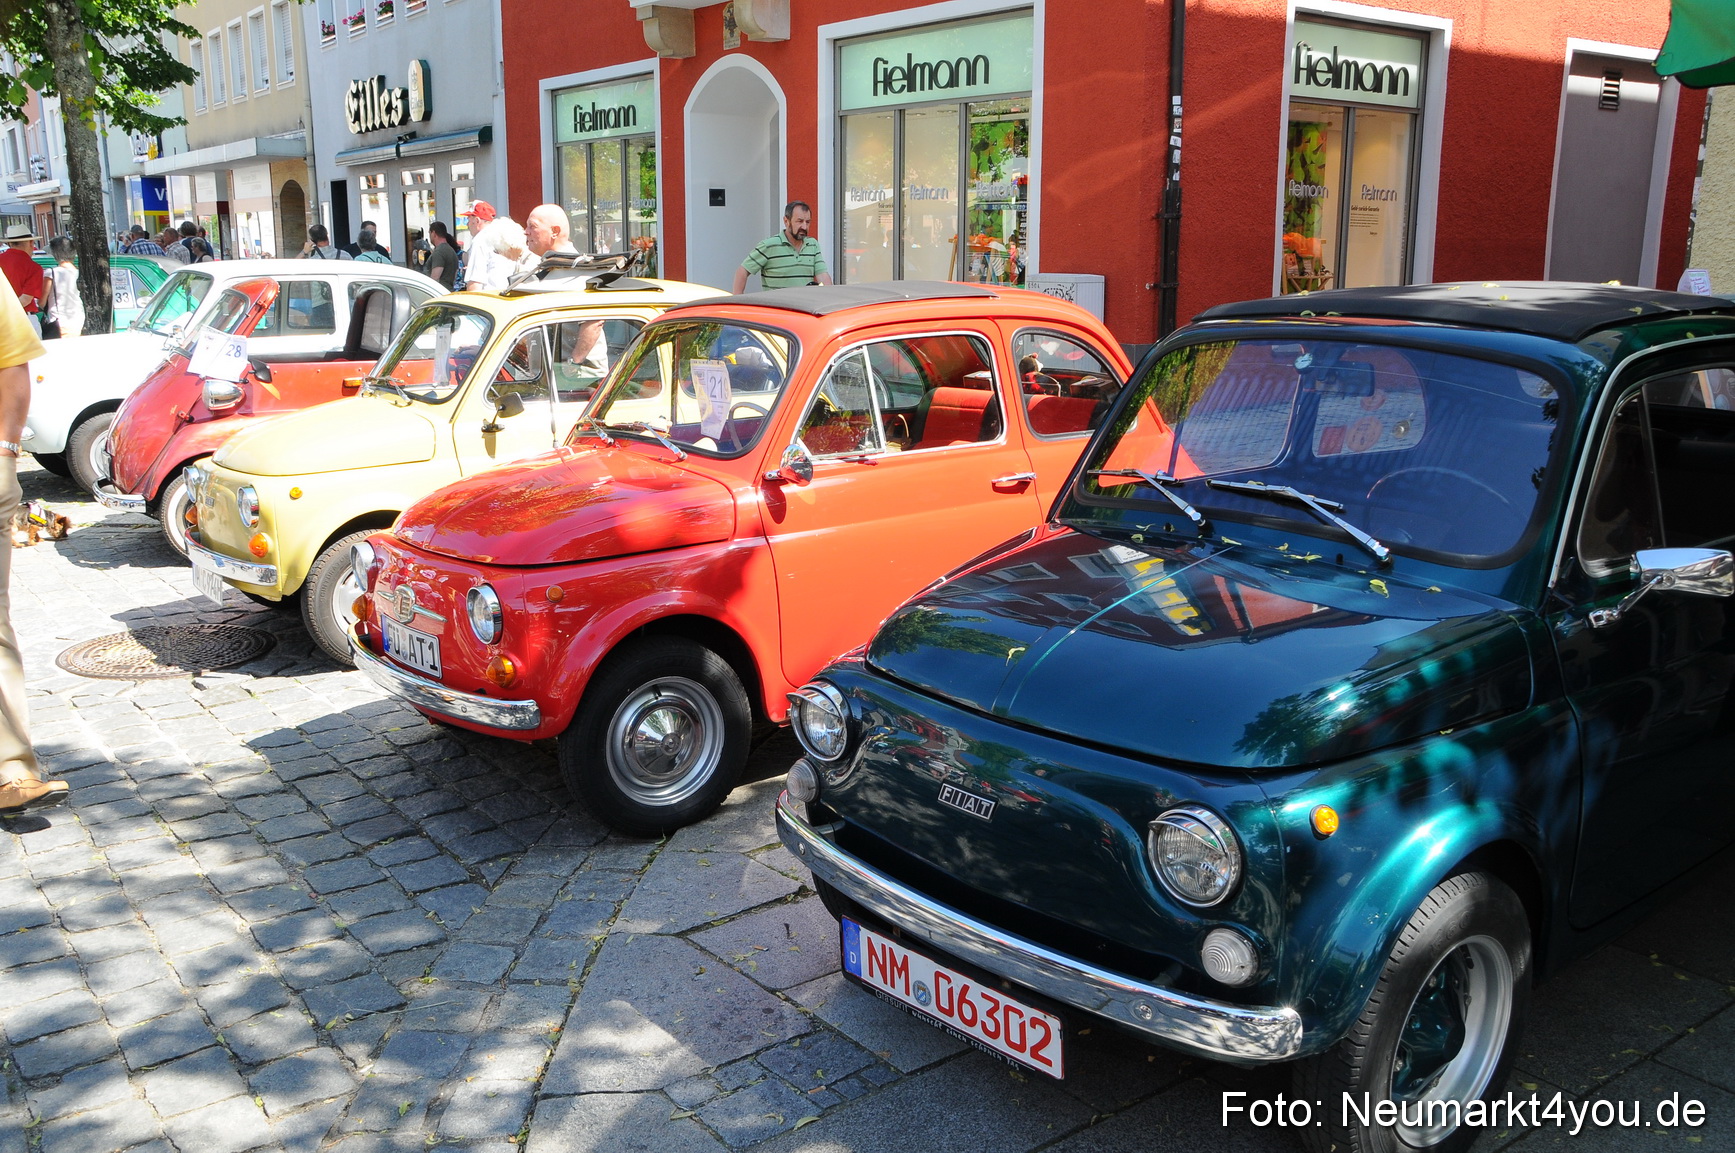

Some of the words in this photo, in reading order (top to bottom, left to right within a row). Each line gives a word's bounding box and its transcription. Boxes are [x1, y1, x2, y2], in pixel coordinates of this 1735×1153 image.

[872, 53, 989, 96] fielmann
[1294, 41, 1410, 96] fielmann
[345, 74, 408, 134] Eilles
[573, 102, 637, 133] fielmann
[850, 186, 886, 202] fielmann
[909, 184, 949, 200] fielmann
[1288, 179, 1329, 199] fielmann
[1361, 184, 1397, 202] fielmann
[115, 292, 130, 303] 33
[225, 343, 242, 358] 28
[408, 633, 425, 667] AT
[428, 641, 438, 672] 1
[942, 786, 991, 816] FIAT
[850, 951, 857, 965] D
[867, 935, 911, 997] NM
[934, 970, 1053, 1068] 06302
